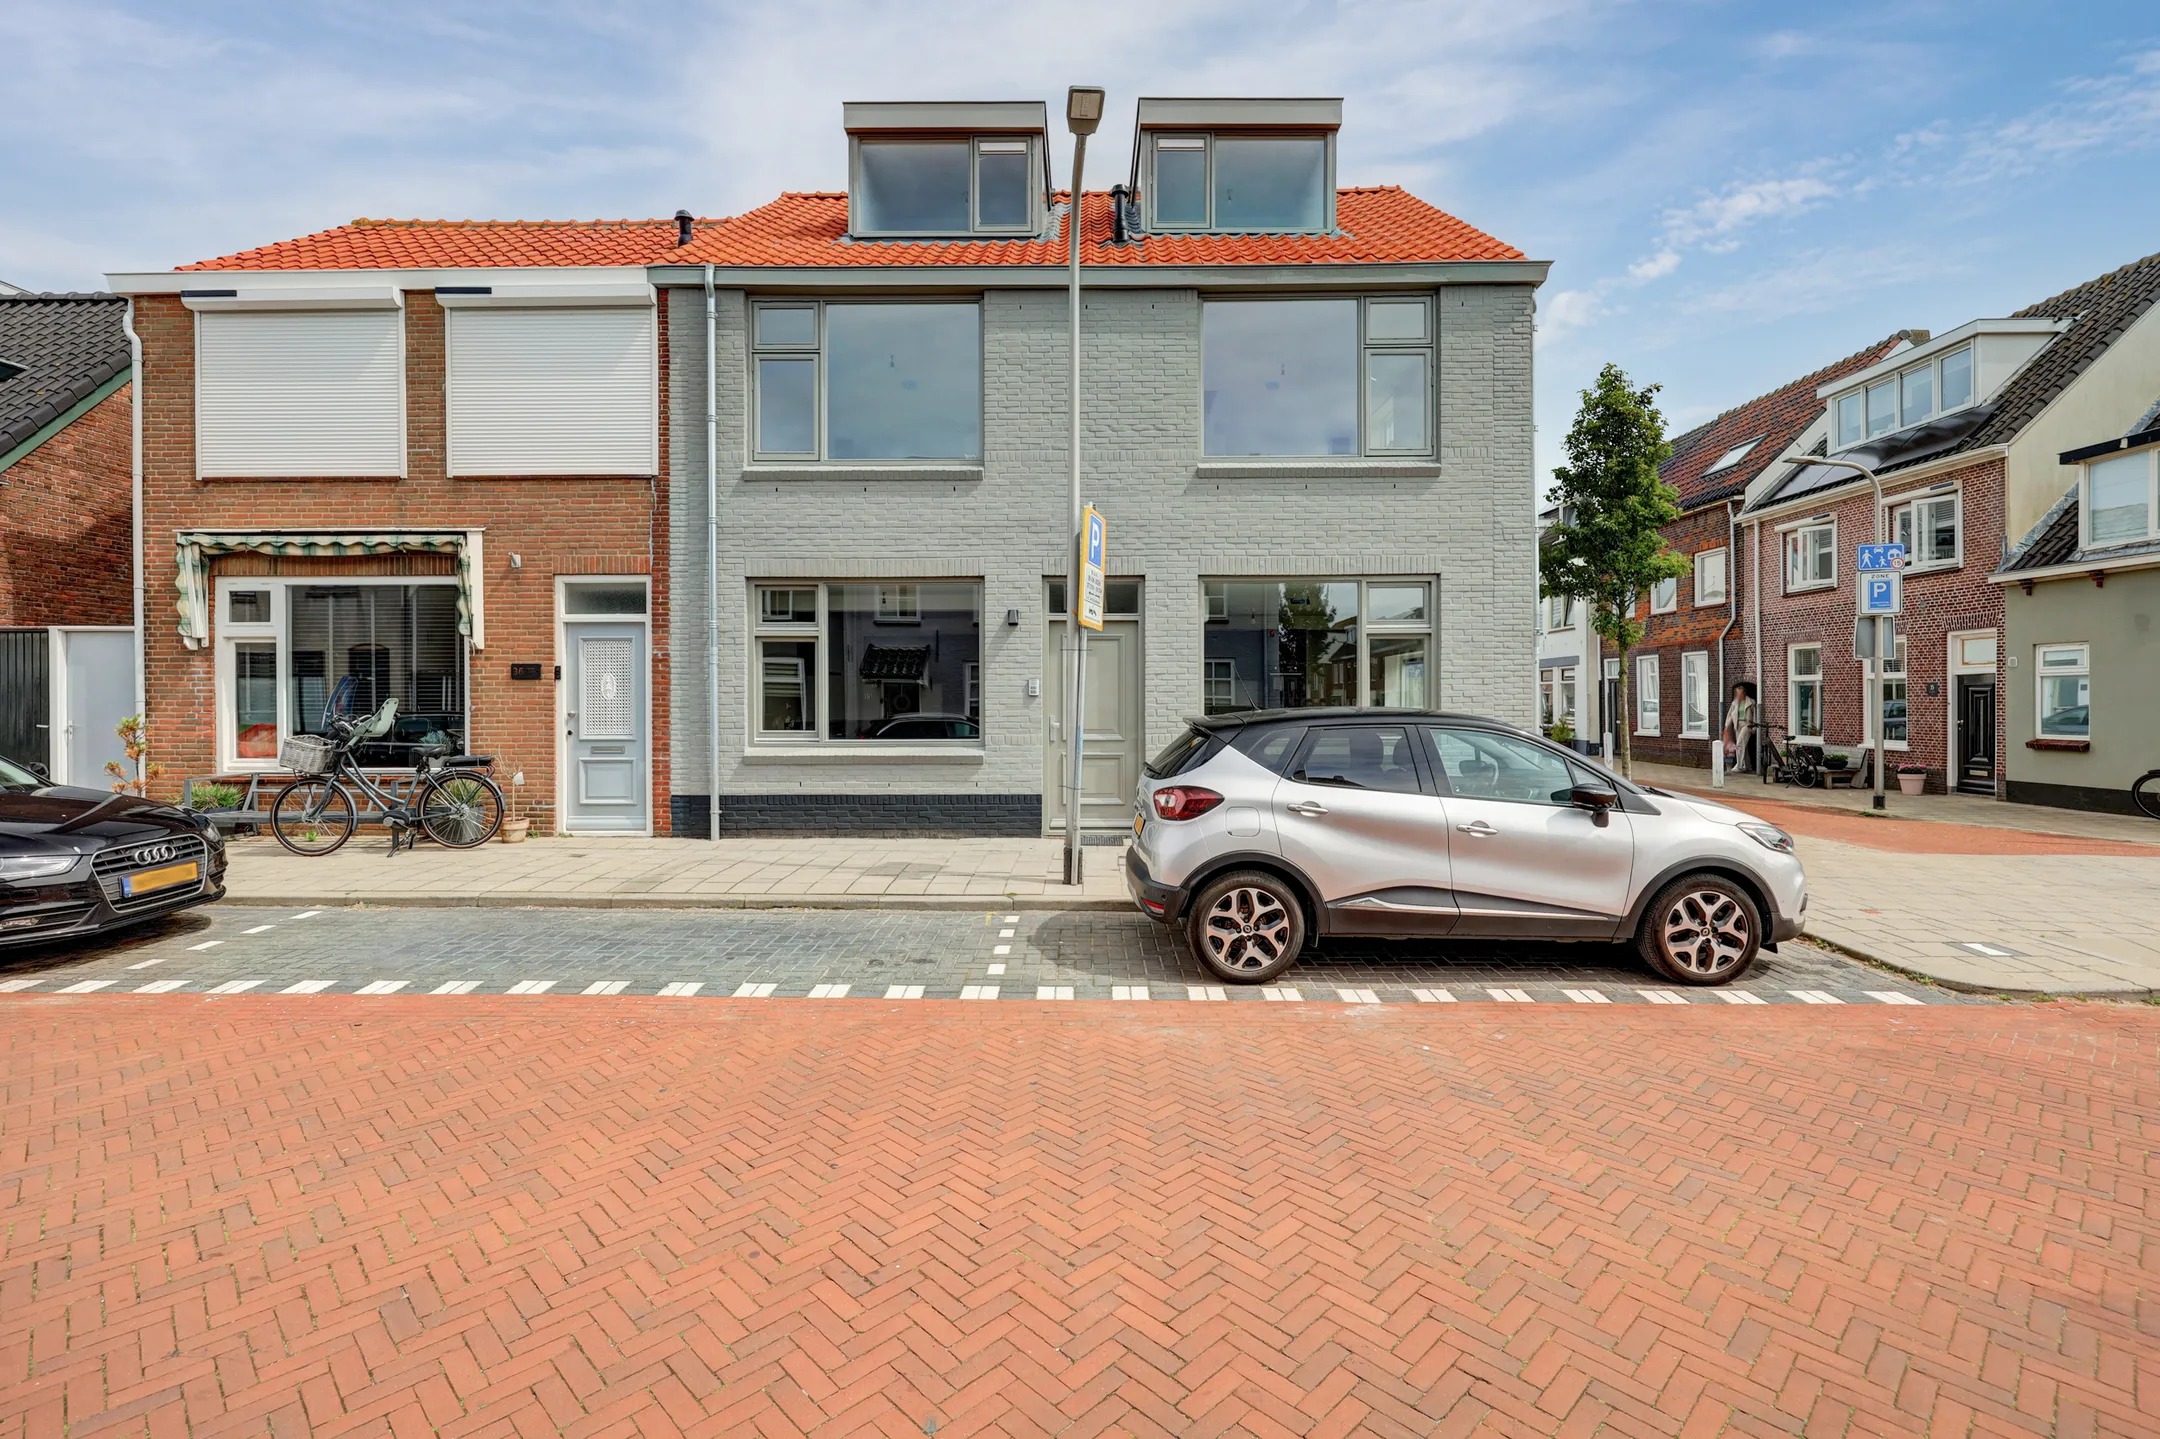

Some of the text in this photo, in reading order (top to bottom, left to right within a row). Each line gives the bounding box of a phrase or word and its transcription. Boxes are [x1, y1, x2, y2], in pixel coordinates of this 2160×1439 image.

[1091, 522, 1100, 559] P
[1873, 582, 1887, 598] P
[512, 667, 524, 675] 36
